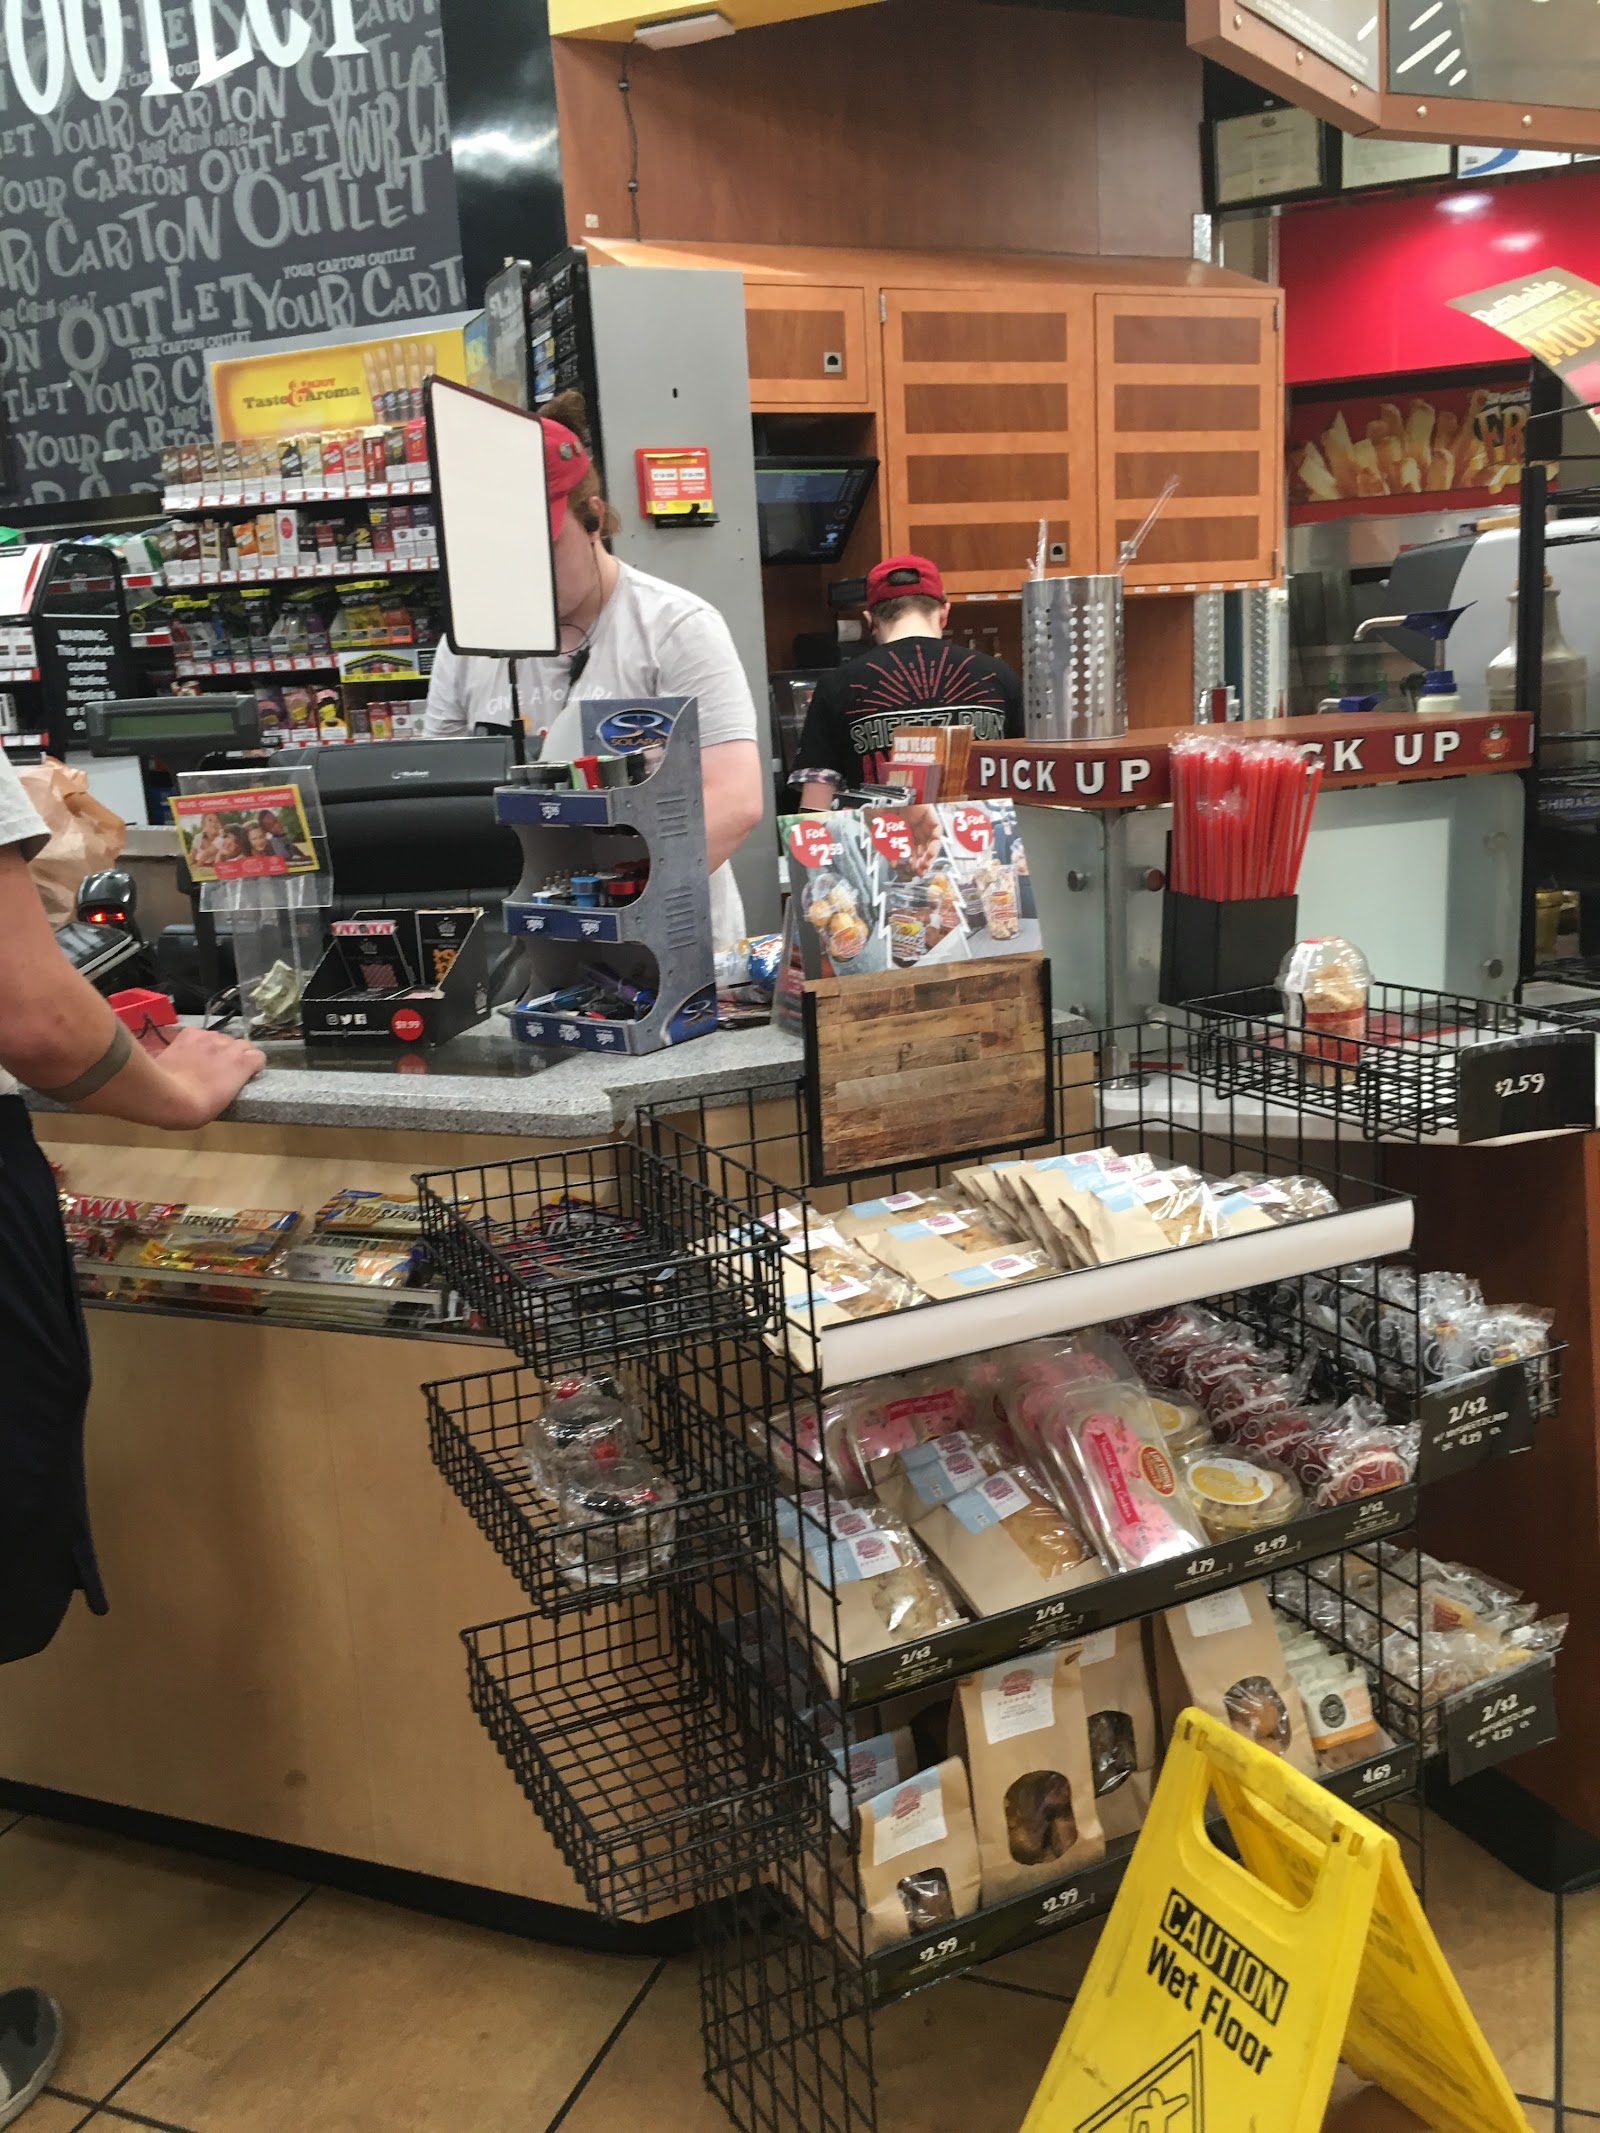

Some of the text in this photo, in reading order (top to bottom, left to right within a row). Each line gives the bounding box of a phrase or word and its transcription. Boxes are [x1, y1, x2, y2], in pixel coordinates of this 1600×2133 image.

[39, 97, 135, 155] YOUR
[140, 66, 286, 137] CARTON
[0, 175, 67, 217] OUR
[72, 152, 188, 202] CARTON
[199, 121, 331, 194] OUTLET
[46, 196, 222, 278] CARTON
[233, 153, 435, 248] OUTLET
[282, 246, 416, 280] YOUR CARTON OUTLET
[58, 265, 253, 371] OUTLET
[246, 274, 356, 331] YOUR
[362, 254, 467, 318] CART
[69, 362, 167, 417] YOUR
[171, 355, 208, 404] C
[242, 379, 361, 410] Taste & Aroma
[16, 430, 101, 475] YOUR
[1394, 730, 1461, 766] UP
[980, 756, 1151, 794] PICK UP
[789, 824, 828, 846] 1 FOR
[871, 813, 908, 839] 2 FOR
[953, 810, 987, 832] 3 FOR
[888, 836, 912, 859] $5
[970, 828, 990, 851] $7
[68, 1193, 142, 1220] TWIX
[1448, 1395, 1489, 1425] 2/$2
[1253, 1534, 1289, 1555] $2.49
[1042, 1887, 1079, 1912] $2.99
[919, 1936, 958, 1962] $2.99
[1162, 1892, 1288, 2025] CAUTION
[1146, 1935, 1273, 2076] Wet Floor
